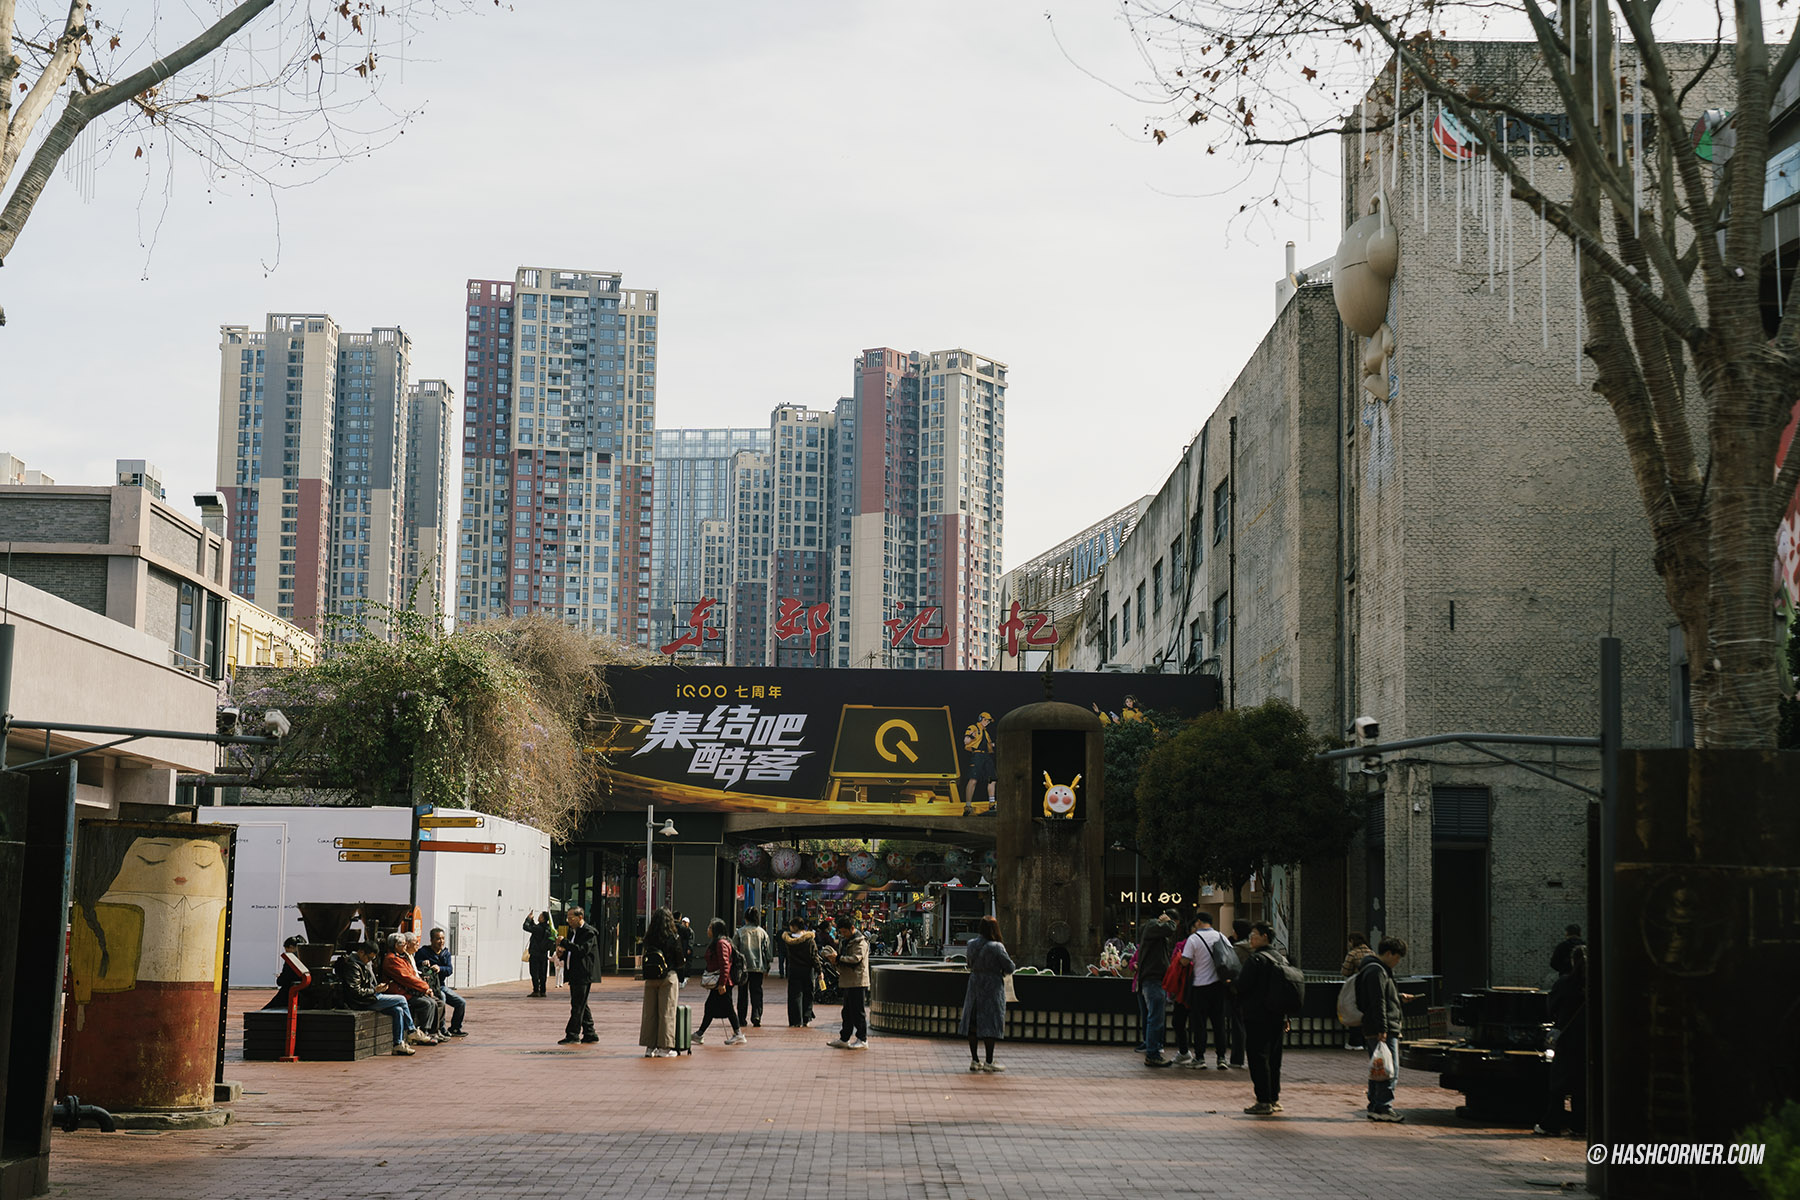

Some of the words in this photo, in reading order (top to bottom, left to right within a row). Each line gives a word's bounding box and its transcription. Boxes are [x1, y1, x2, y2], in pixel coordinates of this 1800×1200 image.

[1072, 521, 1125, 586] IMAX
[660, 596, 1060, 658] 东郊记忆
[676, 684, 728, 698] iQOO
[734, 685, 782, 699] 七周年
[631, 704, 808, 758] 集结吧
[687, 742, 816, 790] 酷客
